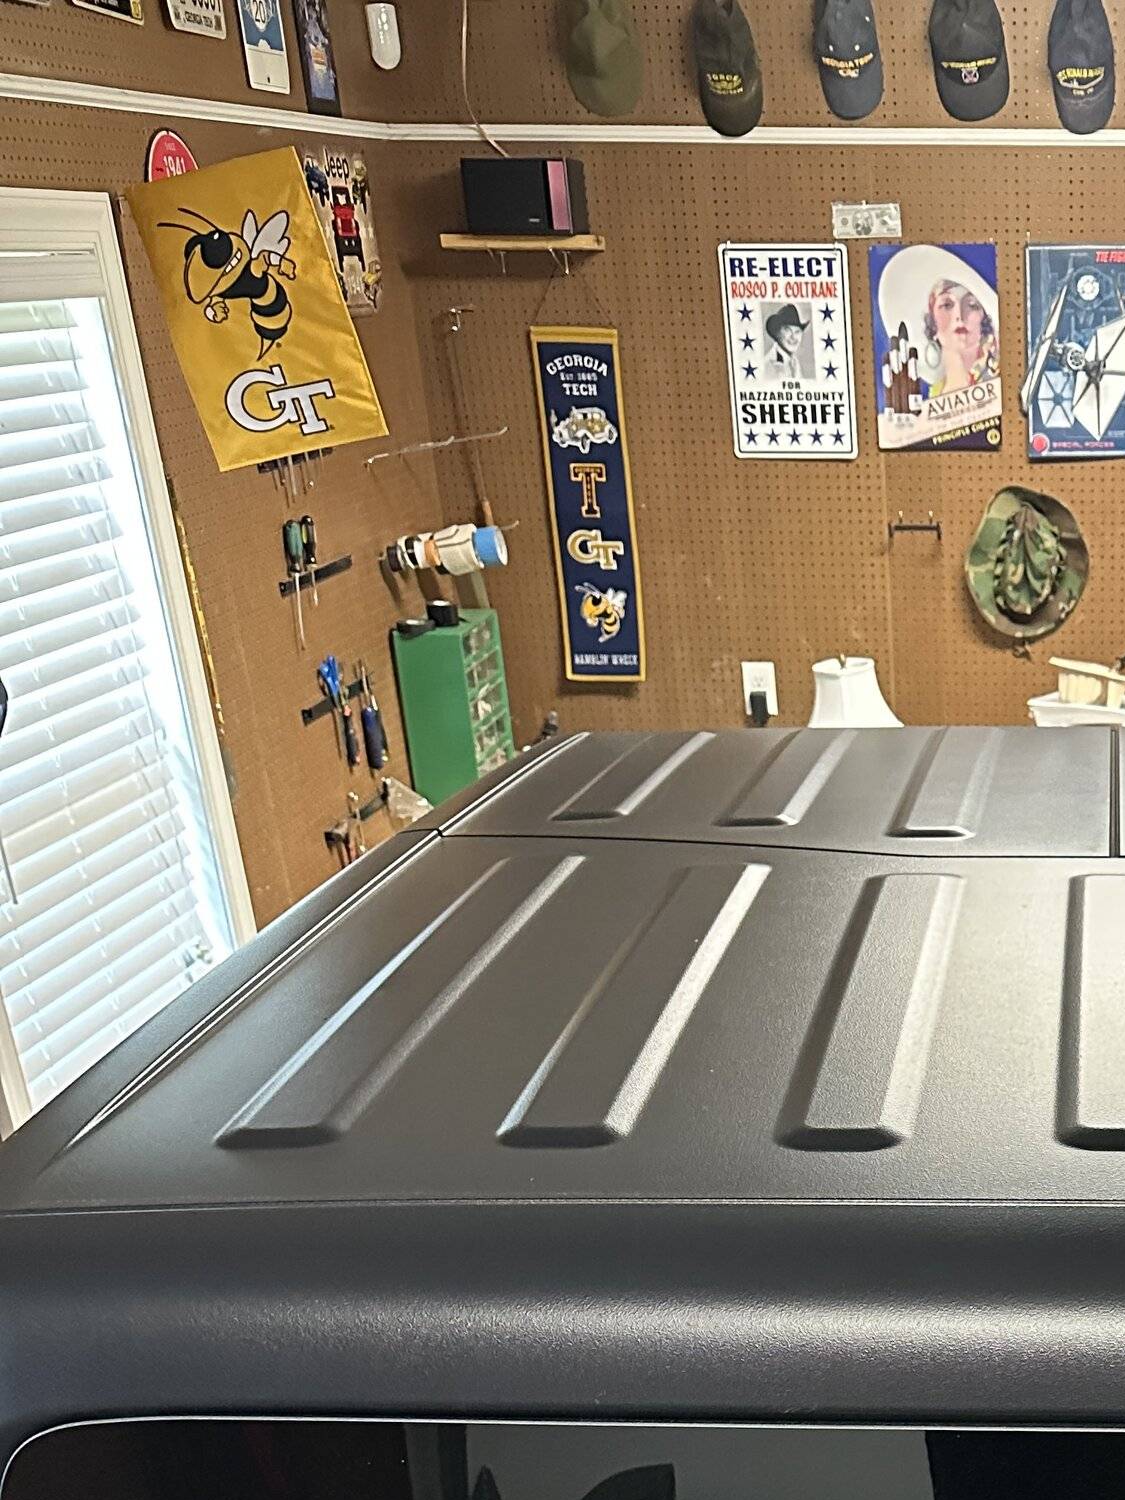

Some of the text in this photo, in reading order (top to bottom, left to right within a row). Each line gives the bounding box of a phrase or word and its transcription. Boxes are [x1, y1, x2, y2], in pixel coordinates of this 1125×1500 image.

[163, 155, 187, 178] 1941
[323, 148, 350, 182] Jeep
[729, 257, 837, 278] RE-ELECT
[730, 281, 838, 299] ROSCO P. COLTRANE
[546, 355, 608, 377] GEORGIA
[562, 383, 598, 397] TECH
[740, 391, 844, 401] HAZZARD COUNTY
[782, 381, 801, 390] FOR
[225, 364, 336, 436] GT
[928, 383, 995, 417] AVIATOR
[741, 403, 845, 425] SHERIFF
